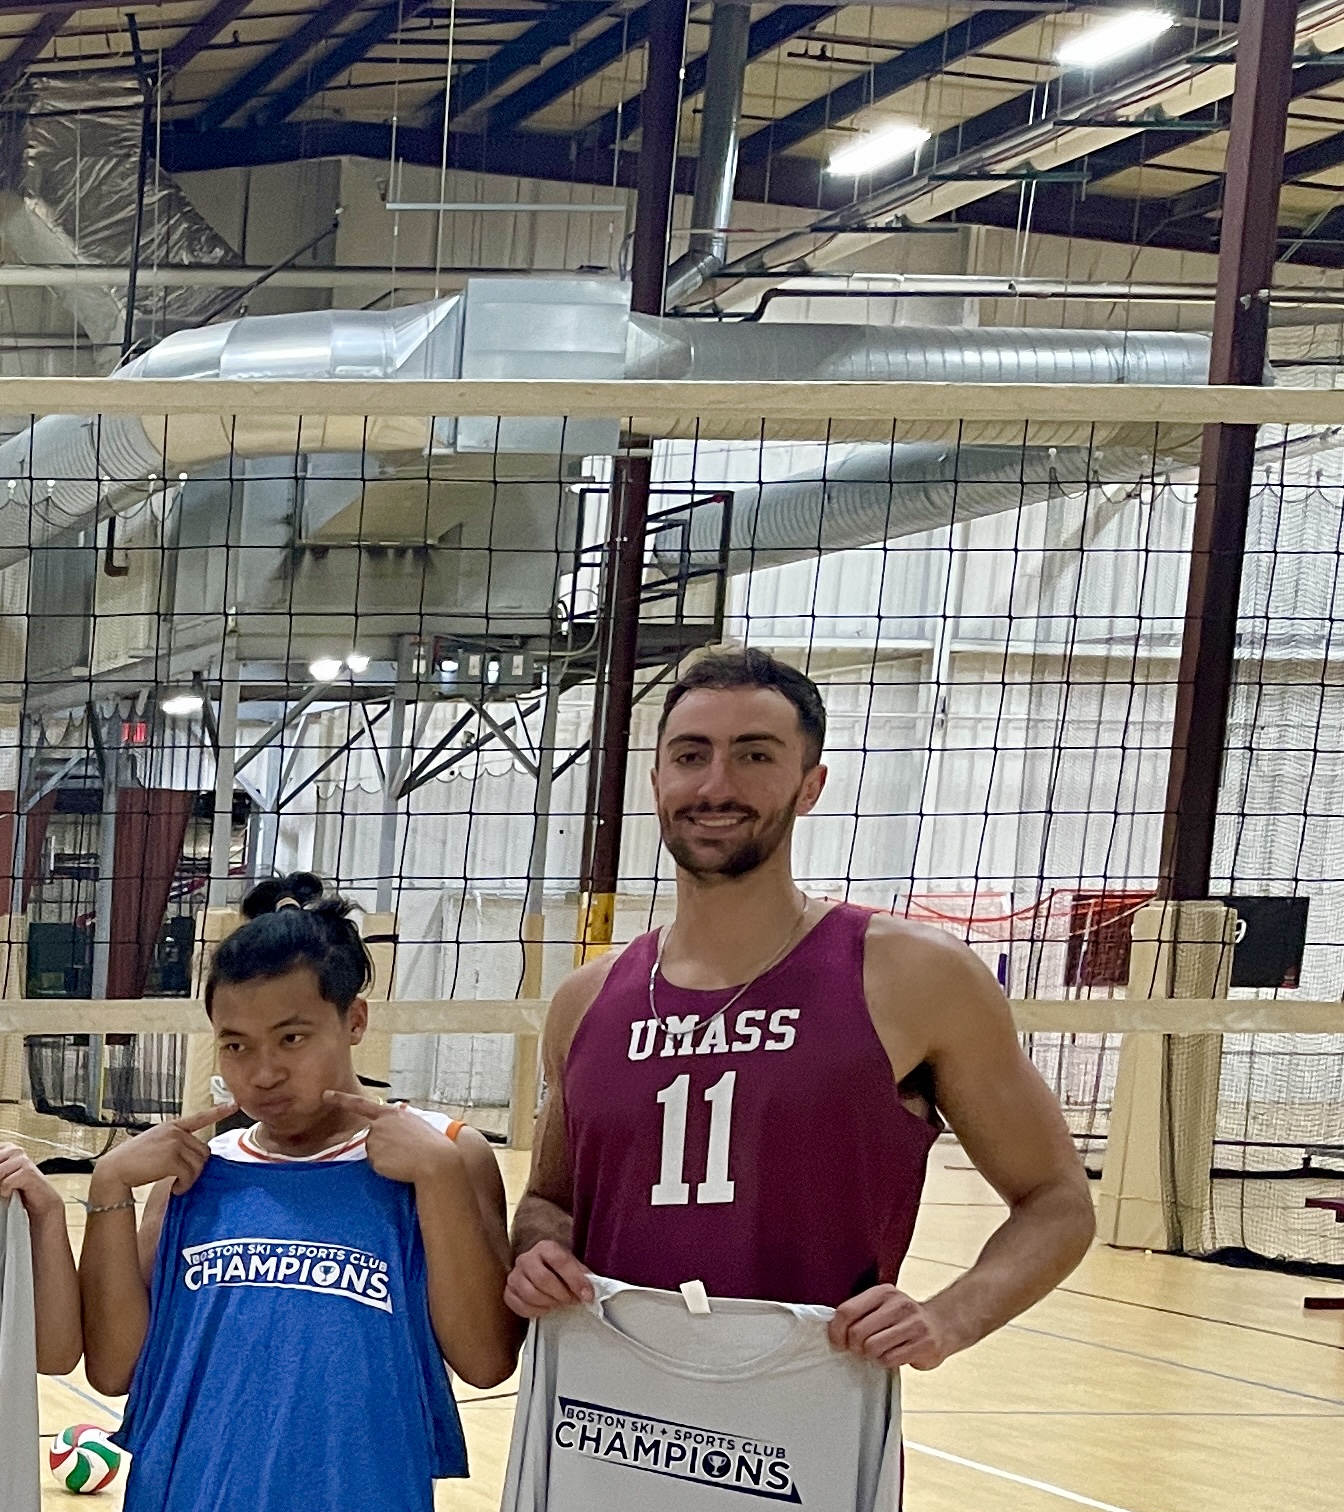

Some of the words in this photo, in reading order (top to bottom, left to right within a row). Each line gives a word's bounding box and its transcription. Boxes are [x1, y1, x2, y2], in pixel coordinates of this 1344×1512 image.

[627, 1008, 800, 1061] UMASS
[650, 1070, 736, 1206] 11
[184, 1255, 389, 1299] CHAMPIONS
[192, 1244, 243, 1265] BOSTON
[247, 1244, 270, 1255] SKI
[288, 1245, 346, 1261] SPORTS
[350, 1253, 388, 1272] CLUB
[555, 1421, 790, 1490] CHAMPIONS
[566, 1407, 626, 1429] BOSTON
[631, 1421, 654, 1435] SKI
[673, 1429, 736, 1451] SPORTS
[742, 1441, 786, 1459] CLUB
